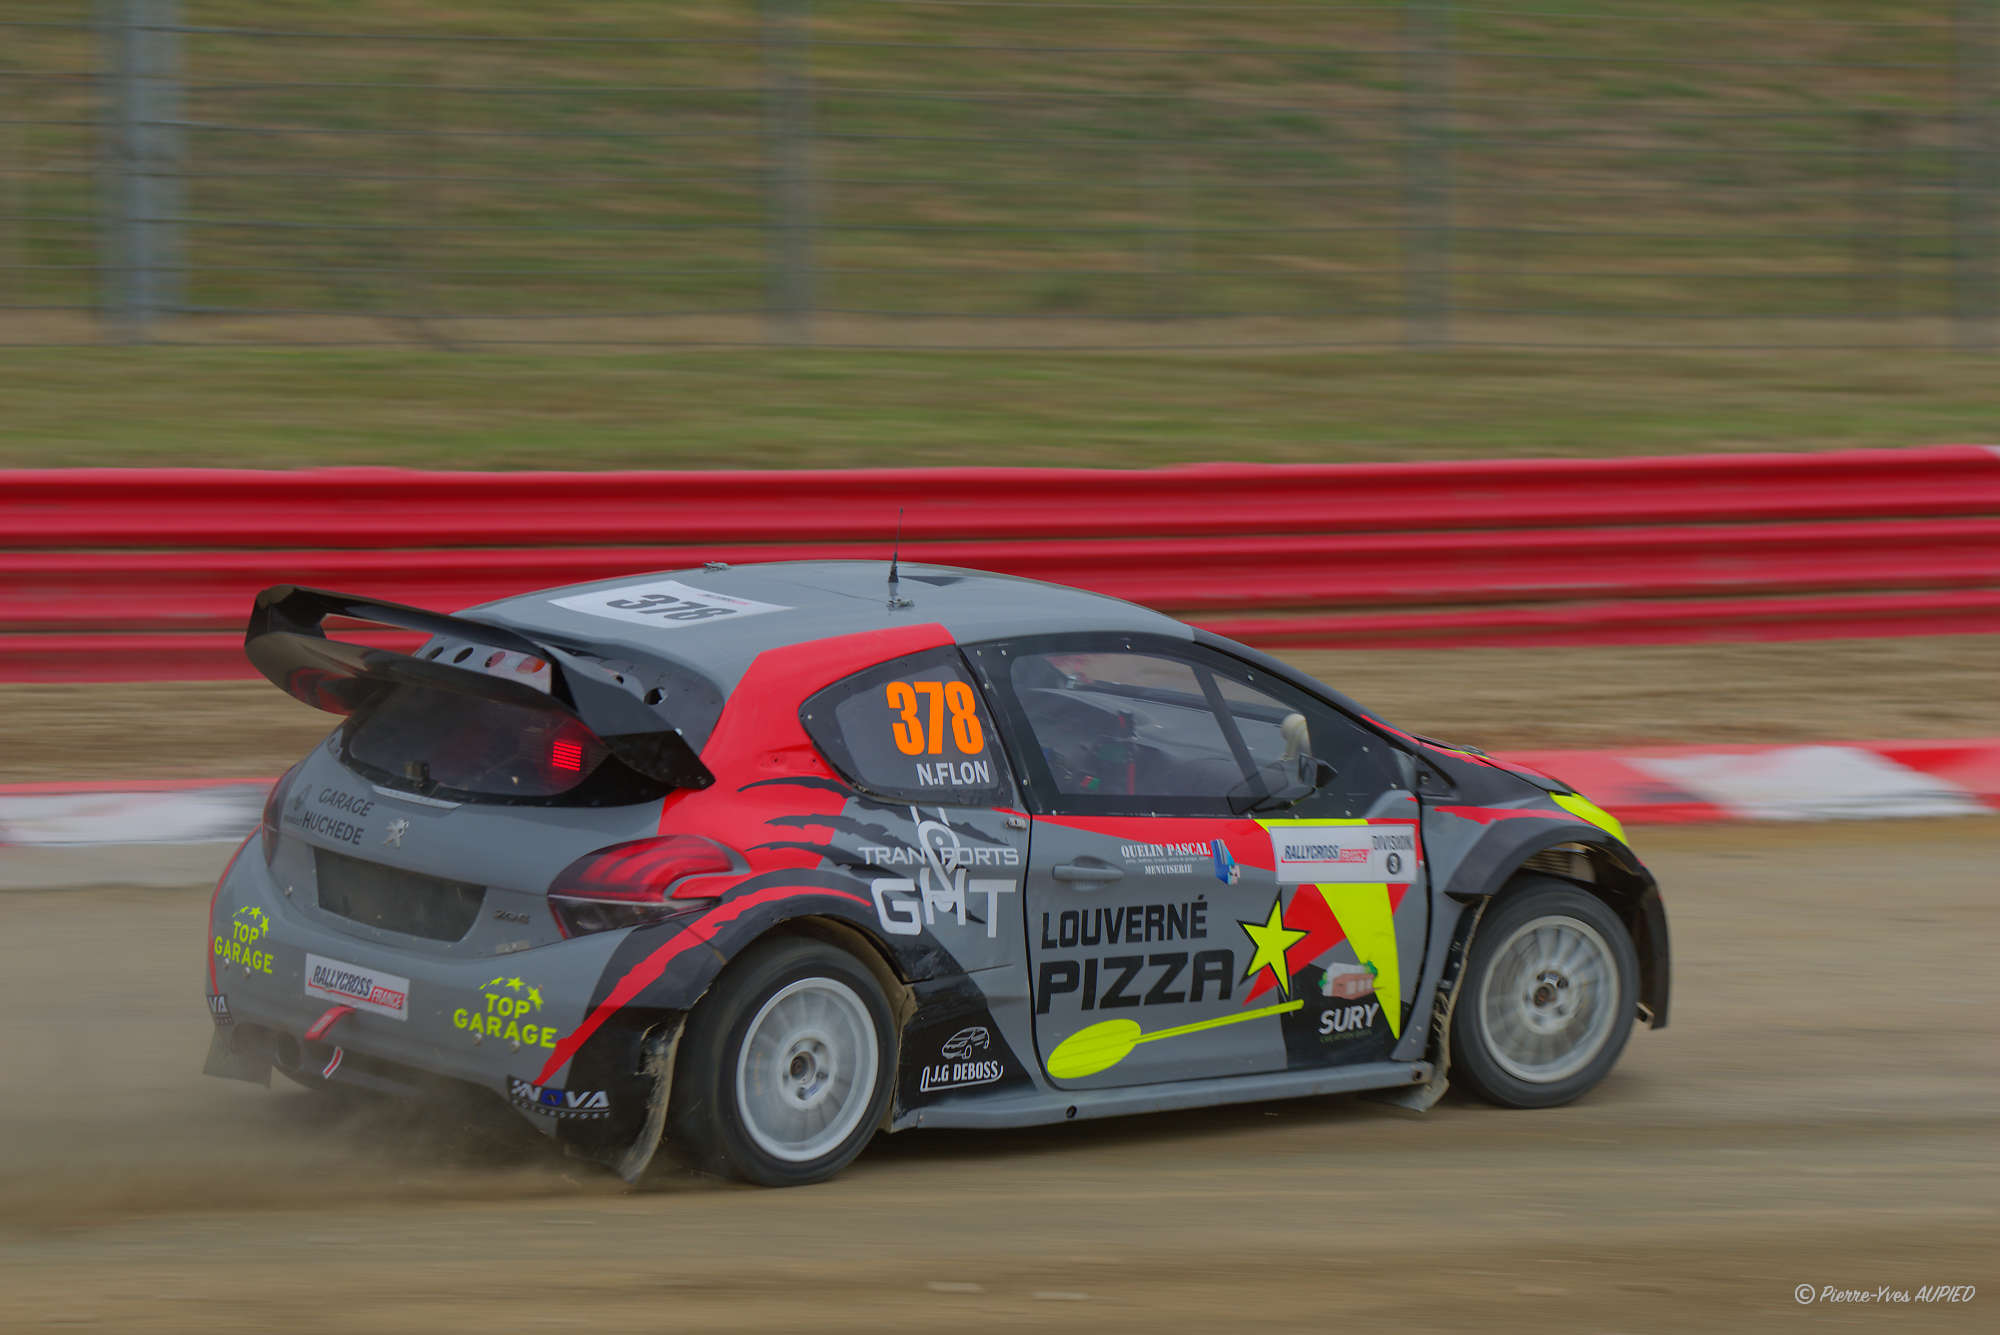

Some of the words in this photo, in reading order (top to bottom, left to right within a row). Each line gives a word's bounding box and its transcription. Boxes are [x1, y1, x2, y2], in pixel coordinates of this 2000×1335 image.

[606, 593, 738, 620] 378
[886, 681, 984, 756] 378
[916, 761, 990, 786] N.FLON
[319, 787, 375, 817] GARAGE
[302, 810, 365, 846] HUCHEDE
[1120, 844, 1164, 858] QUELIN
[1166, 842, 1211, 857] PASCAL
[1284, 845, 1339, 859] RALLYCROSS
[1144, 863, 1193, 876] MENUISERIE
[233, 921, 259, 945] TOP
[1041, 894, 1208, 950] LOUVERNÉ
[214, 935, 274, 974] GARAGE
[313, 965, 373, 998] RALLYCROSS
[1036, 949, 1235, 1015] PIZZA
[485, 993, 531, 1019] TOP
[1319, 1003, 1379, 1034] SURY
[453, 1008, 558, 1049] GARAGE
[952, 1060, 999, 1081] DEBOSS
